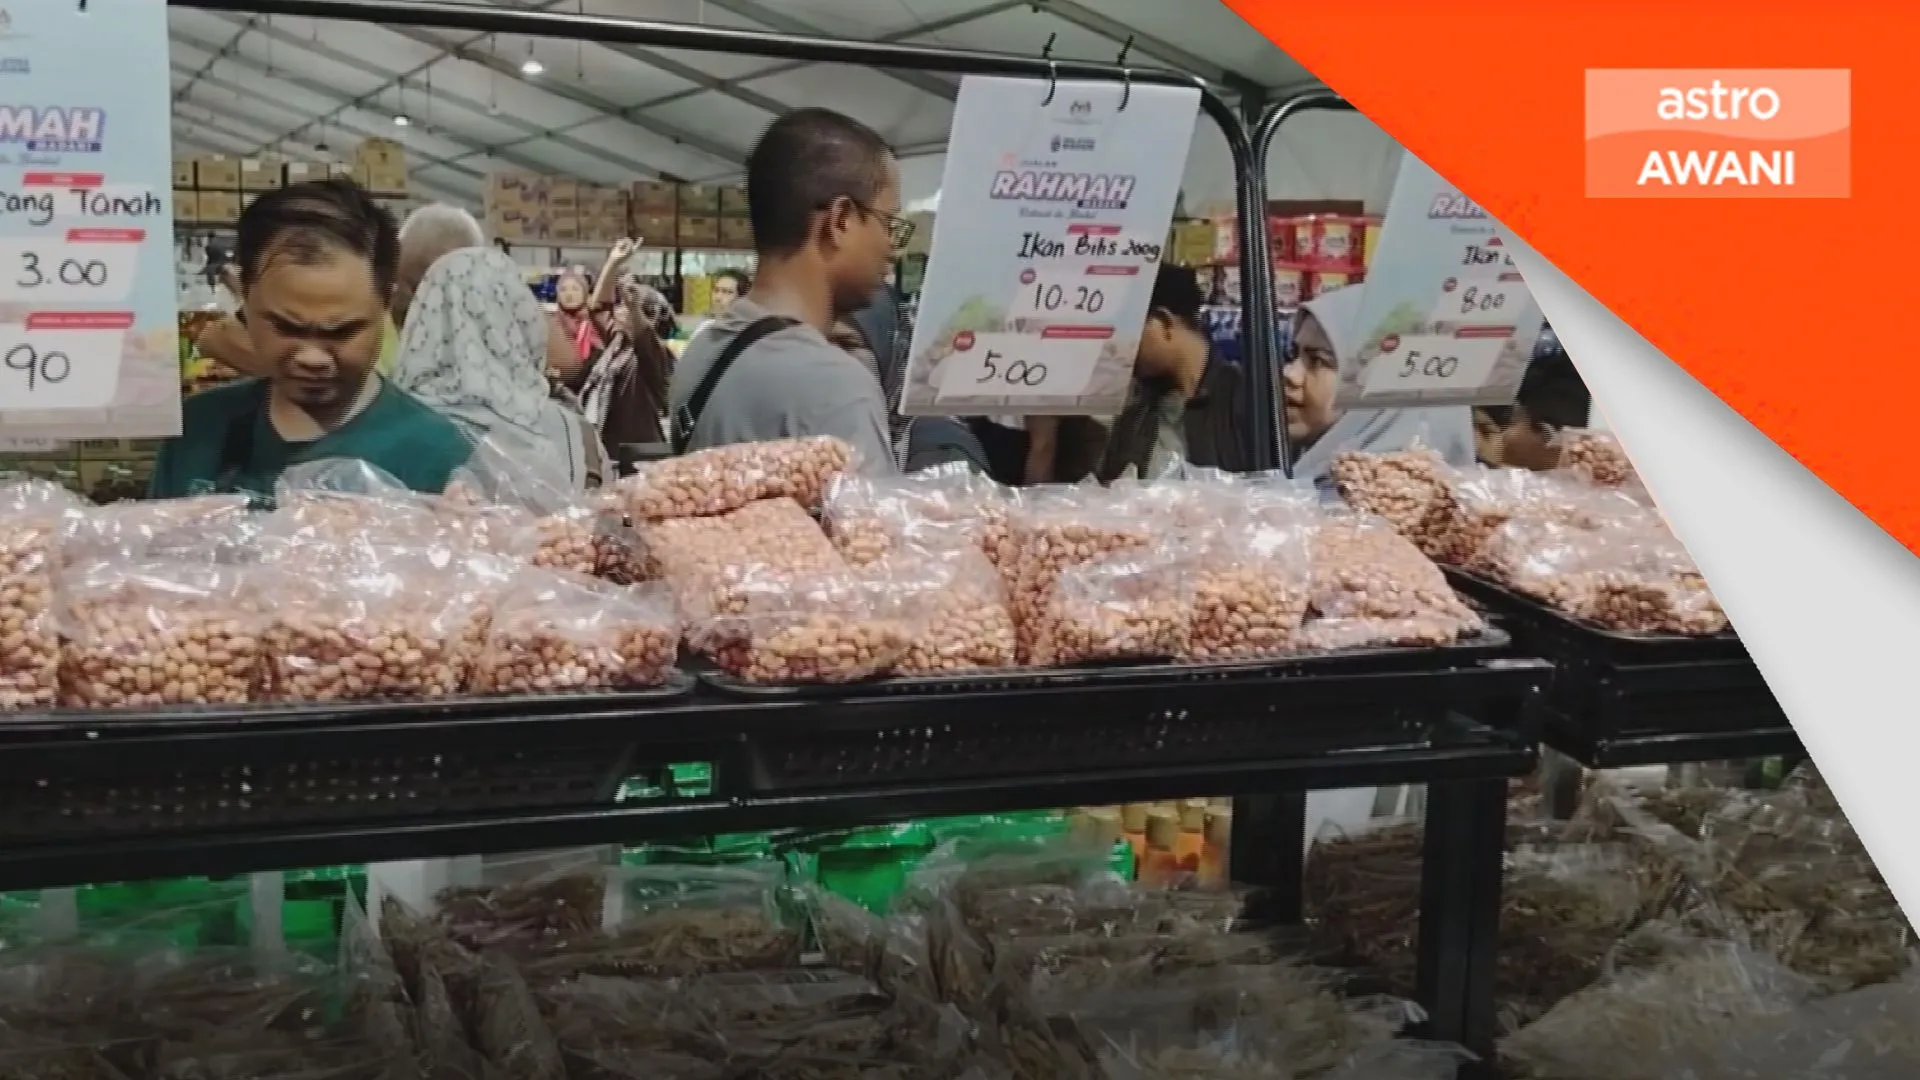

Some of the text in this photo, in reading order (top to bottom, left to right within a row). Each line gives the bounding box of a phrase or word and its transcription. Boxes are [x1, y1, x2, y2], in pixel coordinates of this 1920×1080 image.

[990, 171, 1136, 201] RAHMAH
[69, 189, 161, 216] Tanah
[1017, 231, 1065, 258] Ikan
[17, 251, 107, 288] 3.00
[1033, 282, 1104, 314] 10.20
[975, 349, 1048, 386] 5.00
